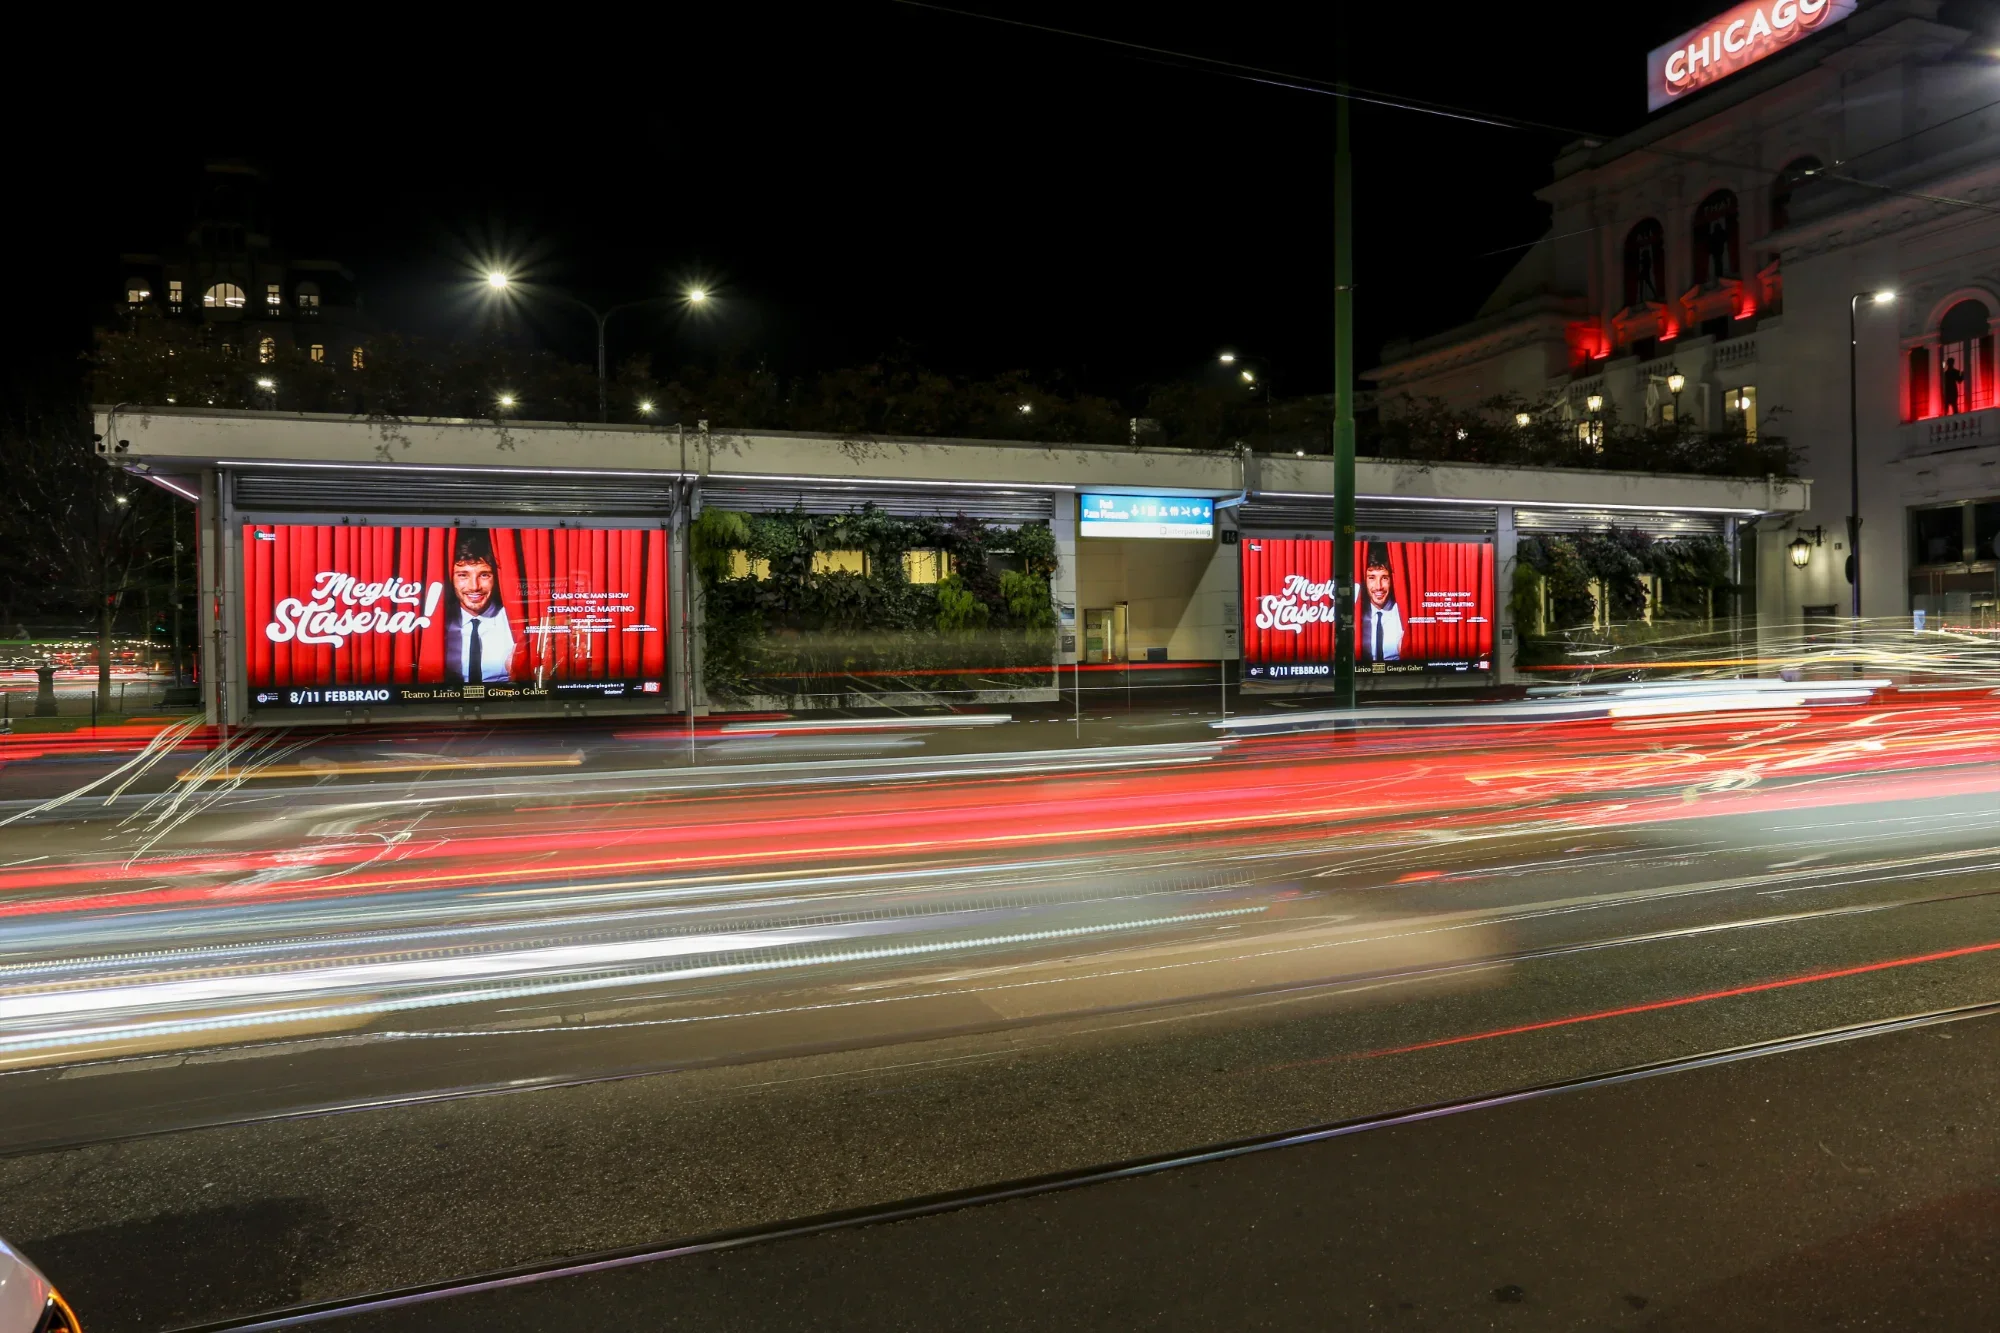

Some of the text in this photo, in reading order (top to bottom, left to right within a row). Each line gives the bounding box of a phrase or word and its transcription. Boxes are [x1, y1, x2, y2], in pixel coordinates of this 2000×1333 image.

[1168, 527, 1211, 537] nterparking
[311, 571, 422, 607] Meglio
[552, 592, 573, 600] QUASI
[1282, 574, 1335, 602] Megli
[265, 582, 443, 649] Stasera!
[597, 605, 635, 613] MARTINO
[1269, 666, 1288, 678] 8/11
[1290, 665, 1329, 676] FEBBRAIO
[1386, 665, 1407, 673] Giorgio
[1407, 664, 1424, 672] Gaber
[289, 690, 320, 705] 8/11
[324, 689, 390, 702] FEBBRAIO
[401, 690, 431, 699] Teatro
[433, 690, 461, 698] Lirico
[487, 688, 520, 698] Giorgio
[522, 687, 549, 696] Gaber
